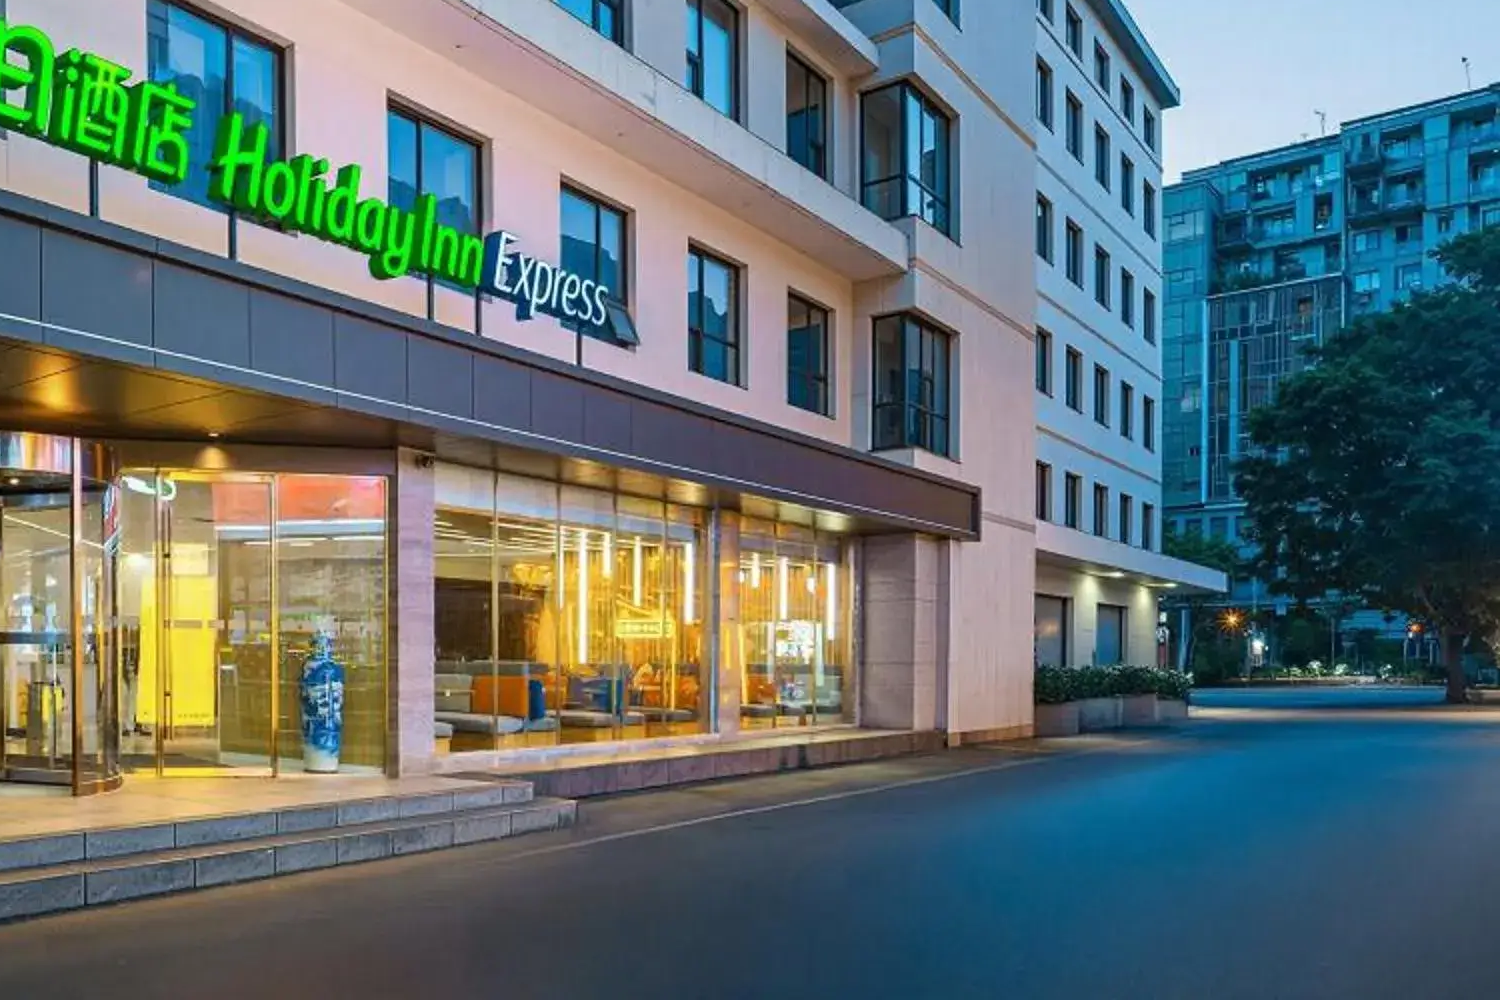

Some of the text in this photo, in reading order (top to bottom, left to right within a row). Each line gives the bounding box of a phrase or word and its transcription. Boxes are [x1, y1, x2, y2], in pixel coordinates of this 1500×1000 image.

[208, 111, 610, 326] Holiday Inn Express
